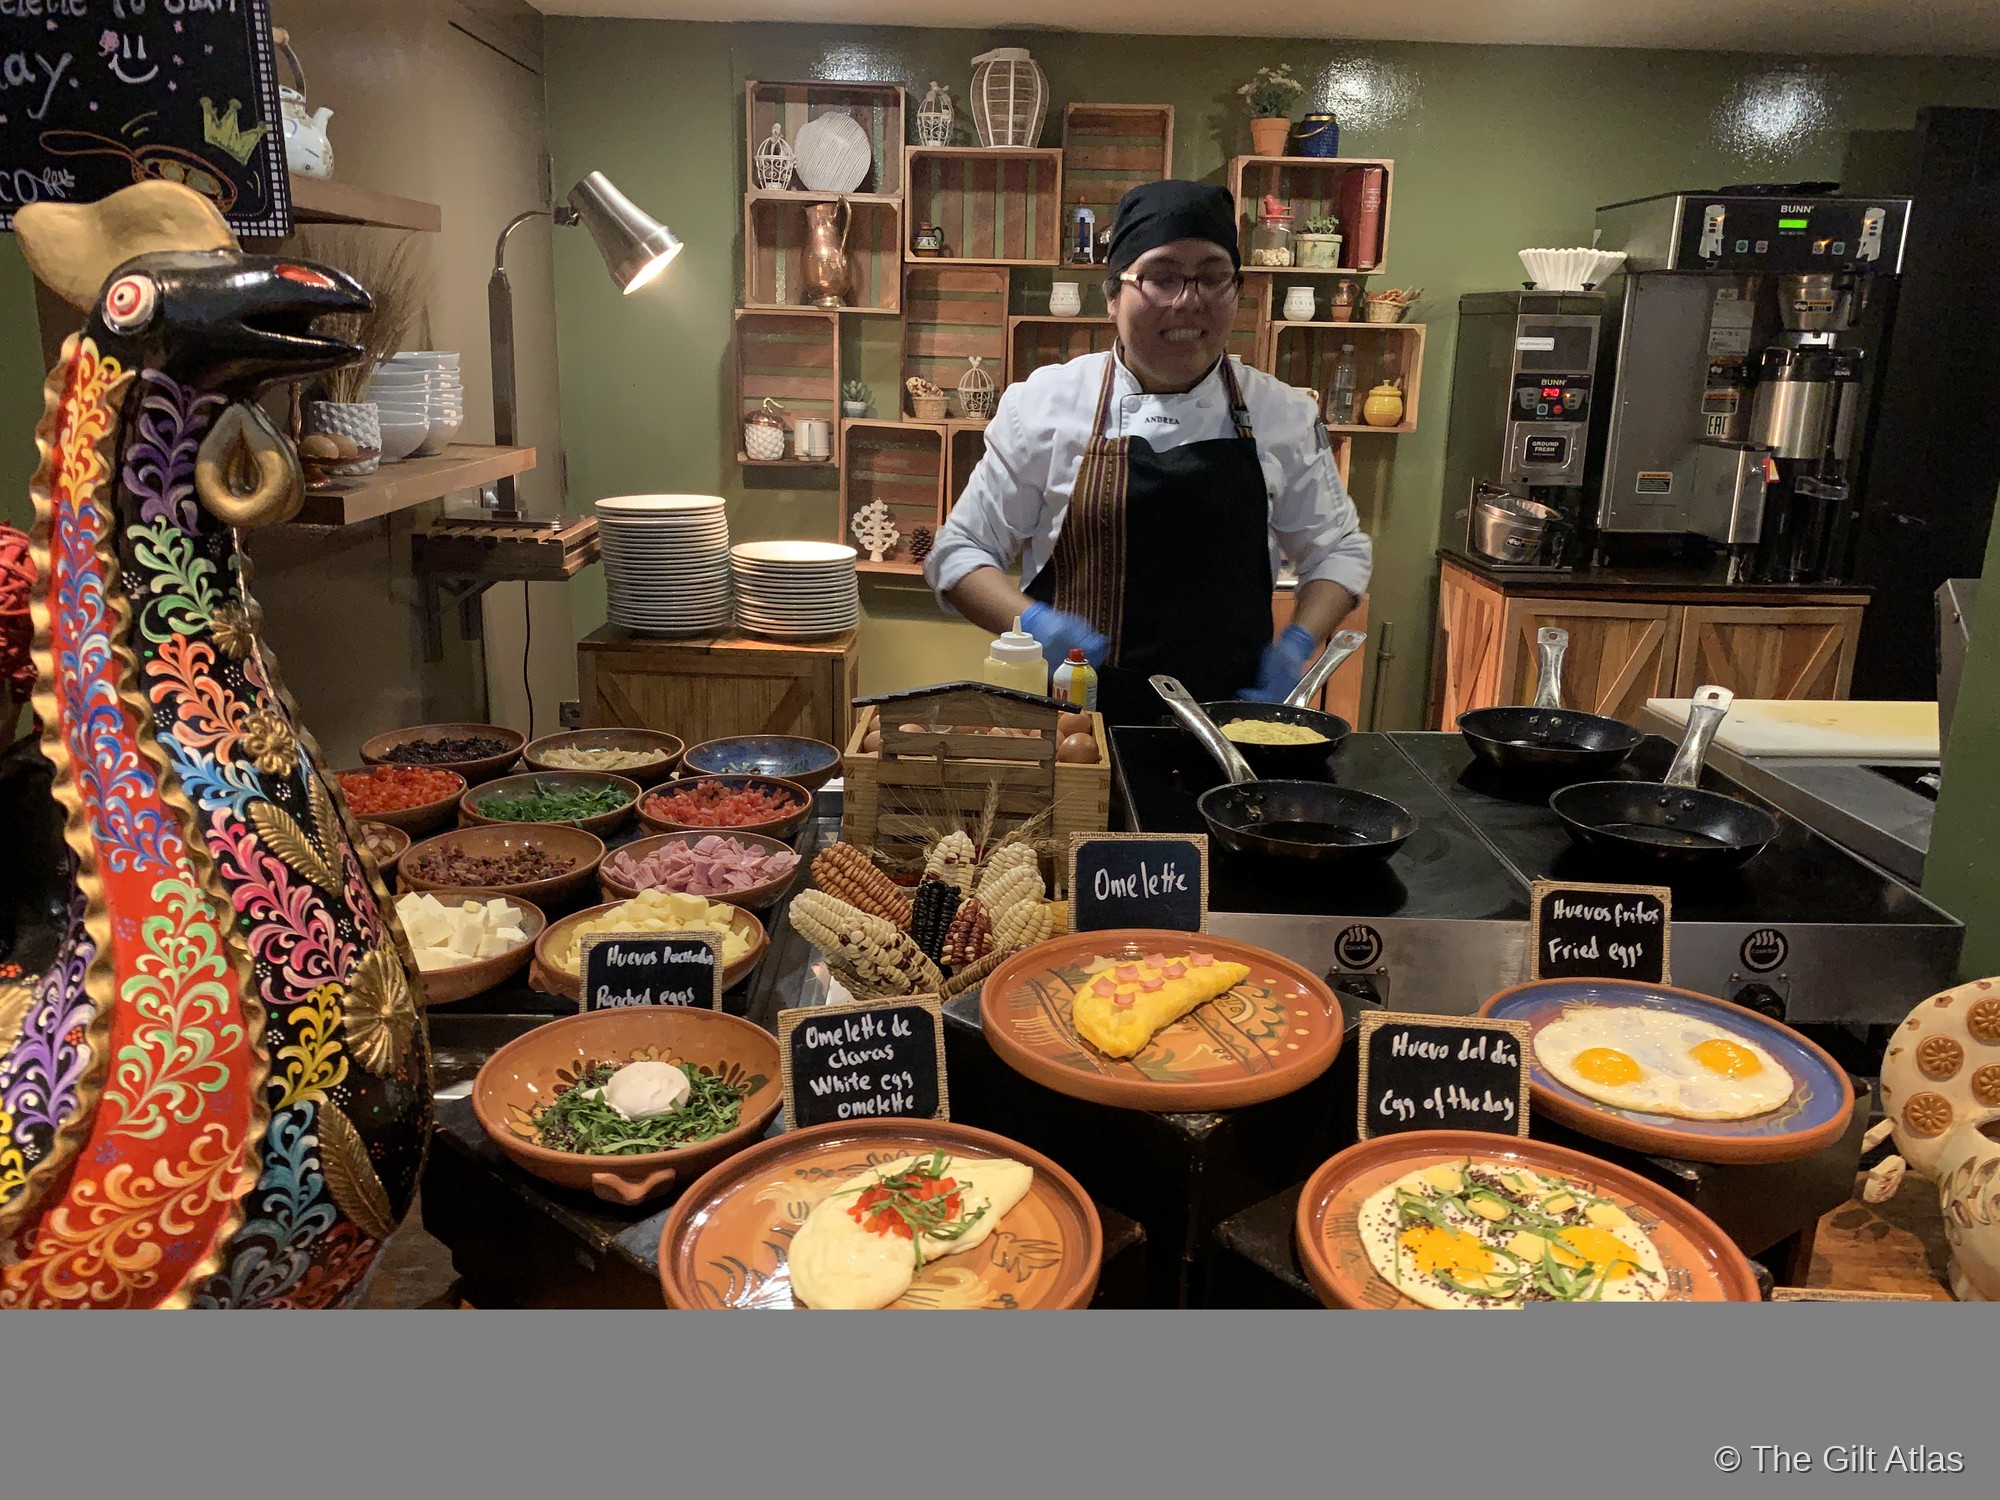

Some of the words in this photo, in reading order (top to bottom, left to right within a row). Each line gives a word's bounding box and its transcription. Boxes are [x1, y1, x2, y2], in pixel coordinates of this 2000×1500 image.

[1780, 205, 1812, 214] BUNN
[1144, 416, 1180, 425] ANDREA
[1094, 861, 1188, 900] Omelette
[1553, 899, 1612, 921] Huevos
[606, 944, 657, 967] Huevos
[1548, 935, 1600, 963] Fried
[1608, 943, 1643, 968] eggs
[805, 1013, 886, 1049] Omelette
[891, 1013, 912, 1037] de
[1392, 1032, 1449, 1060] Huevo
[809, 1072, 872, 1096] White
[881, 1071, 914, 1091] egg
